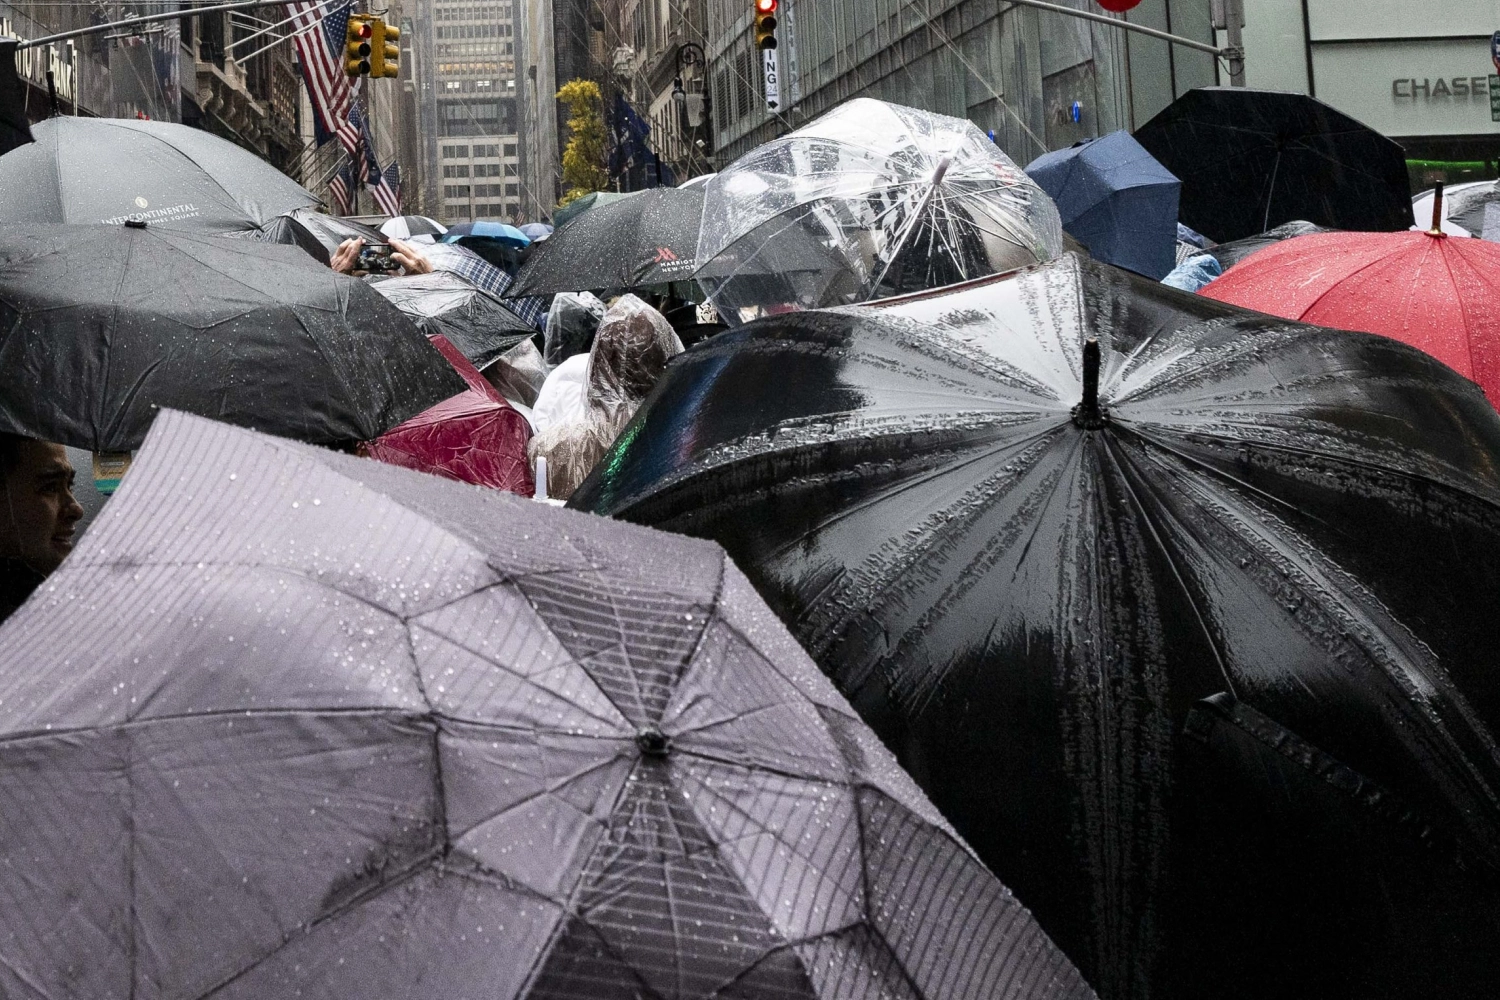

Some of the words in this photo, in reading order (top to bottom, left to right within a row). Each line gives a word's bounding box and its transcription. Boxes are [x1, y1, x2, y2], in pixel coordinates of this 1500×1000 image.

[1392, 76, 1489, 98] CHASE
[147, 216, 168, 226] TIMES
[171, 211, 200, 221] SQUARE
[661, 265, 678, 273] NEW
